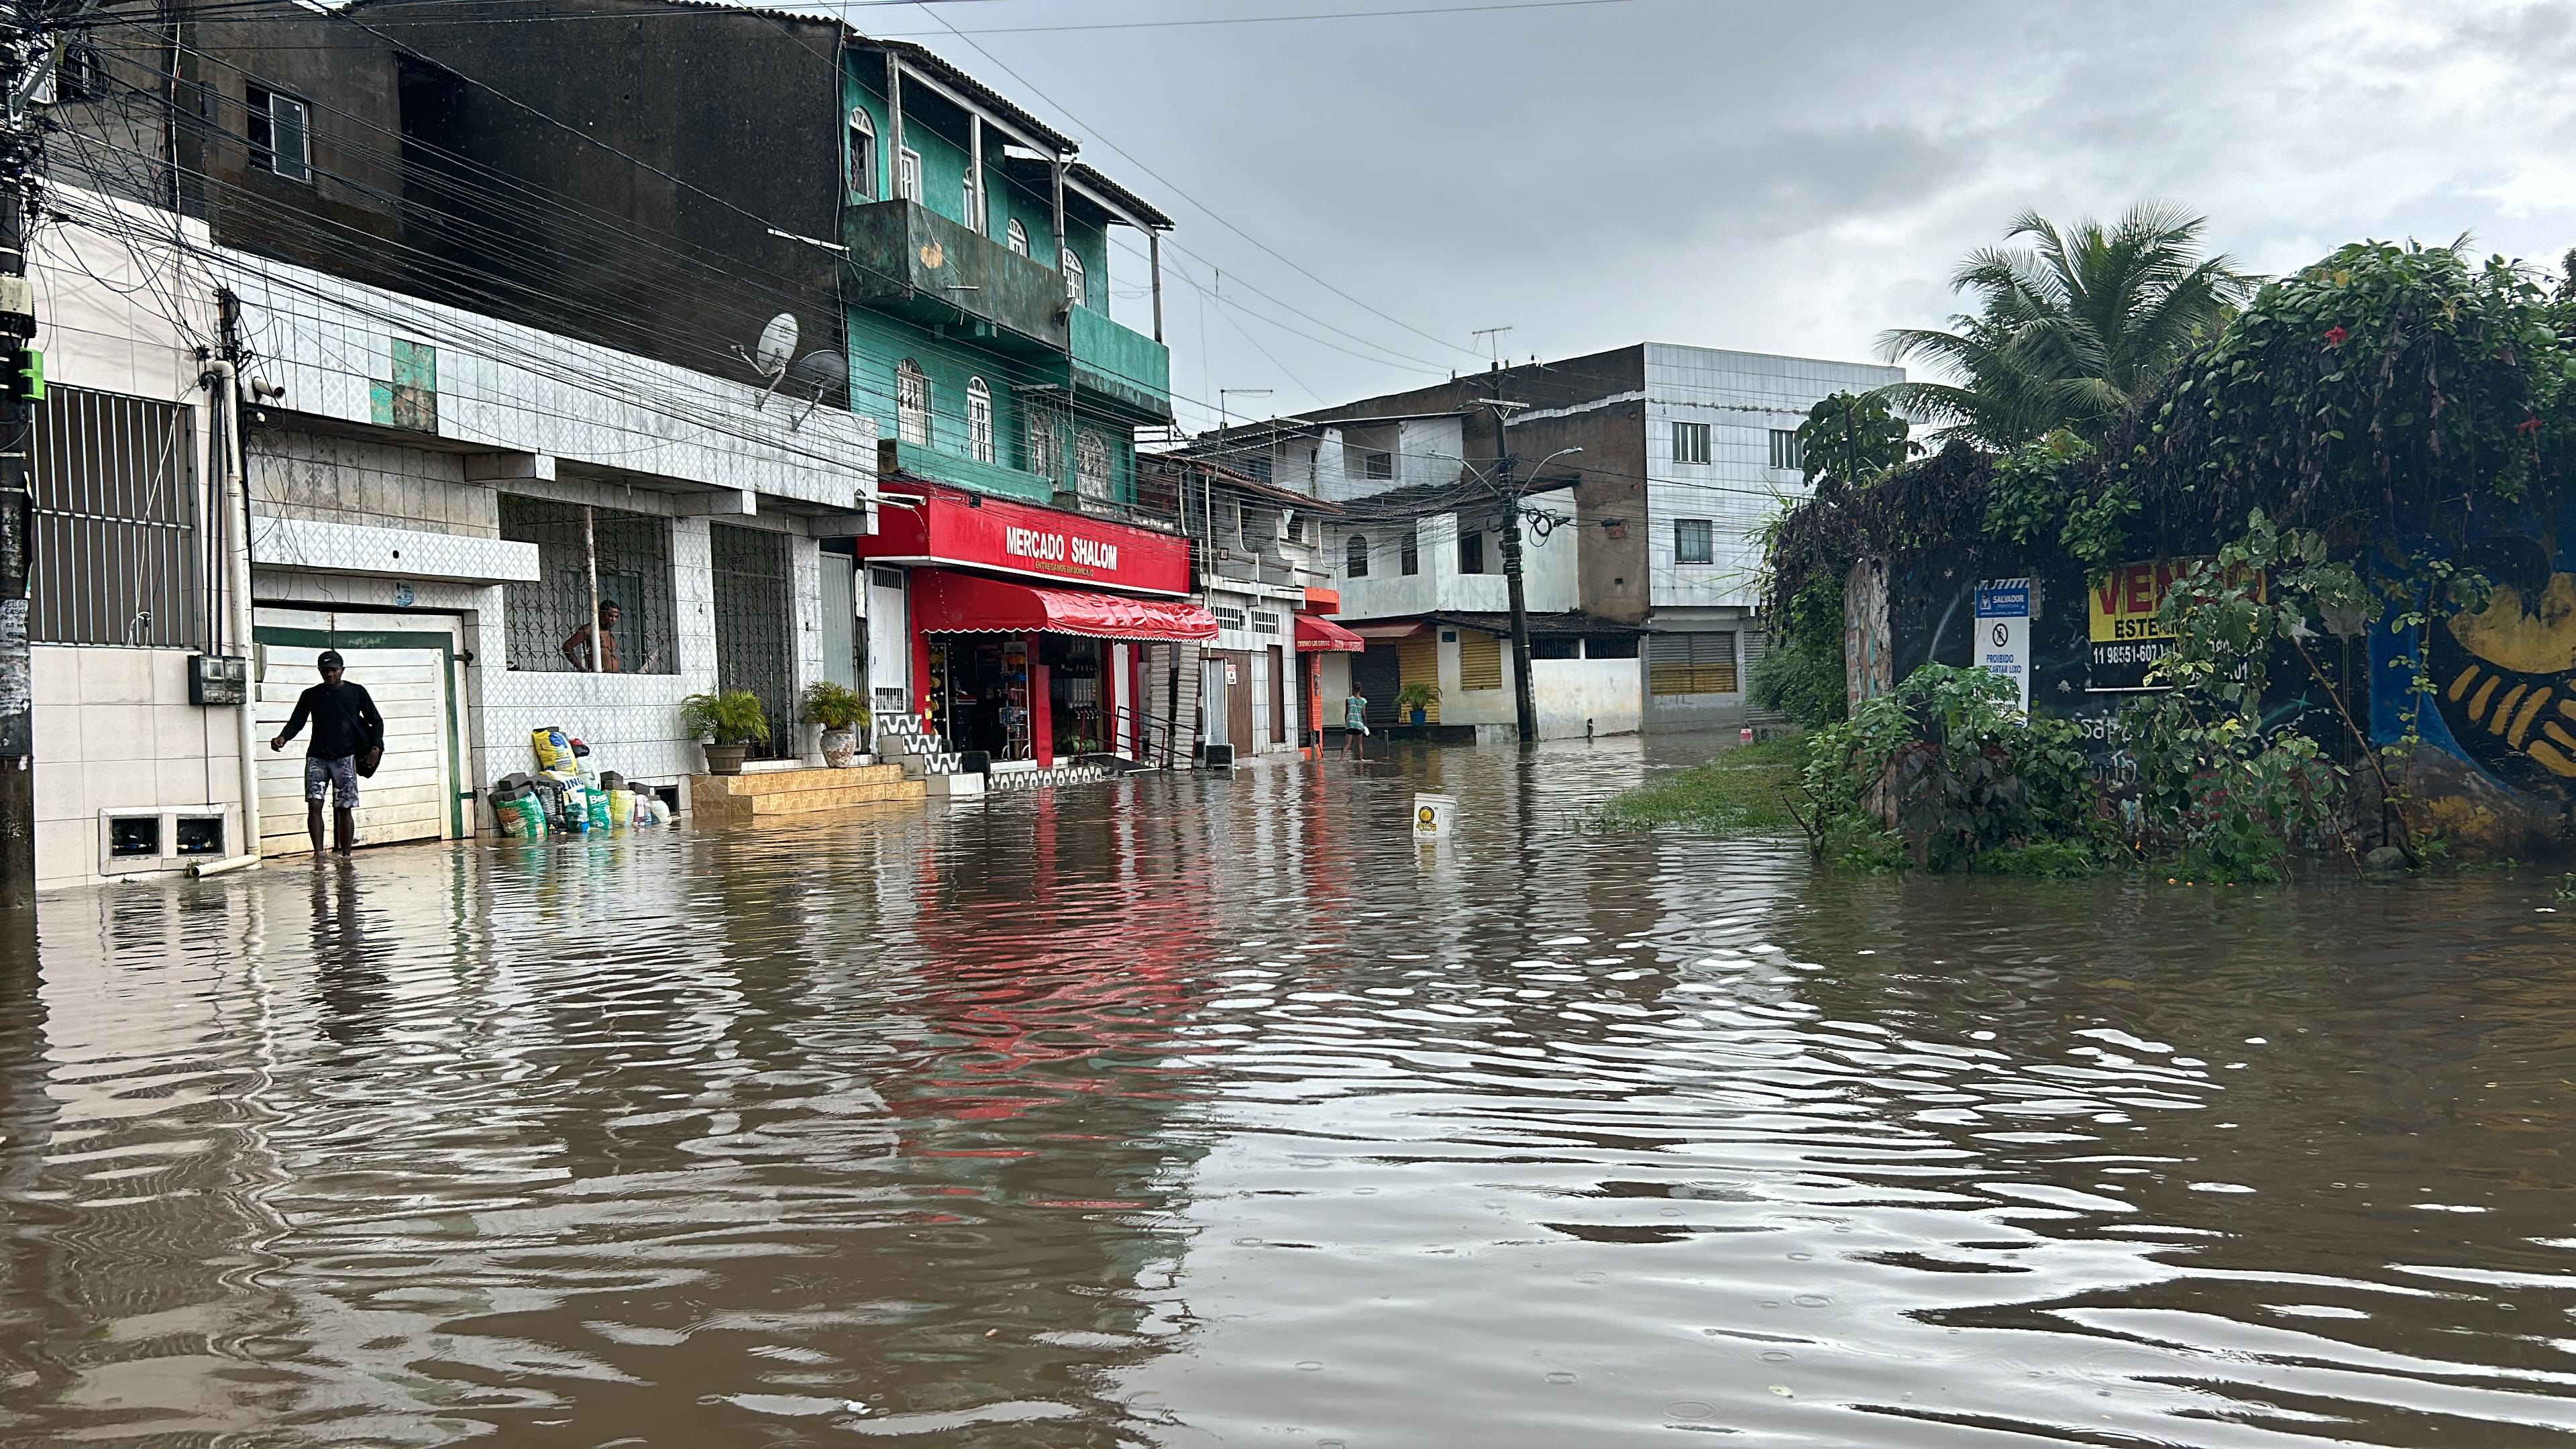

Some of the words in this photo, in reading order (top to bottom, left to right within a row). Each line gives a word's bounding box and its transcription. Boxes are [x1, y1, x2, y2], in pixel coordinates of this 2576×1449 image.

[1006, 526, 1065, 561] MERCADO
[1071, 536, 1118, 570] SHALOM
[1035, 561, 1066, 573] ENTREGAMOS
[1992, 595, 2024, 603] SALVADOR
[2114, 618, 2158, 638] ESTE
[1986, 654, 2014, 663] PROIBIDO
[2093, 647, 2104, 664] 11
[2009, 665, 2021, 673] LIXO
